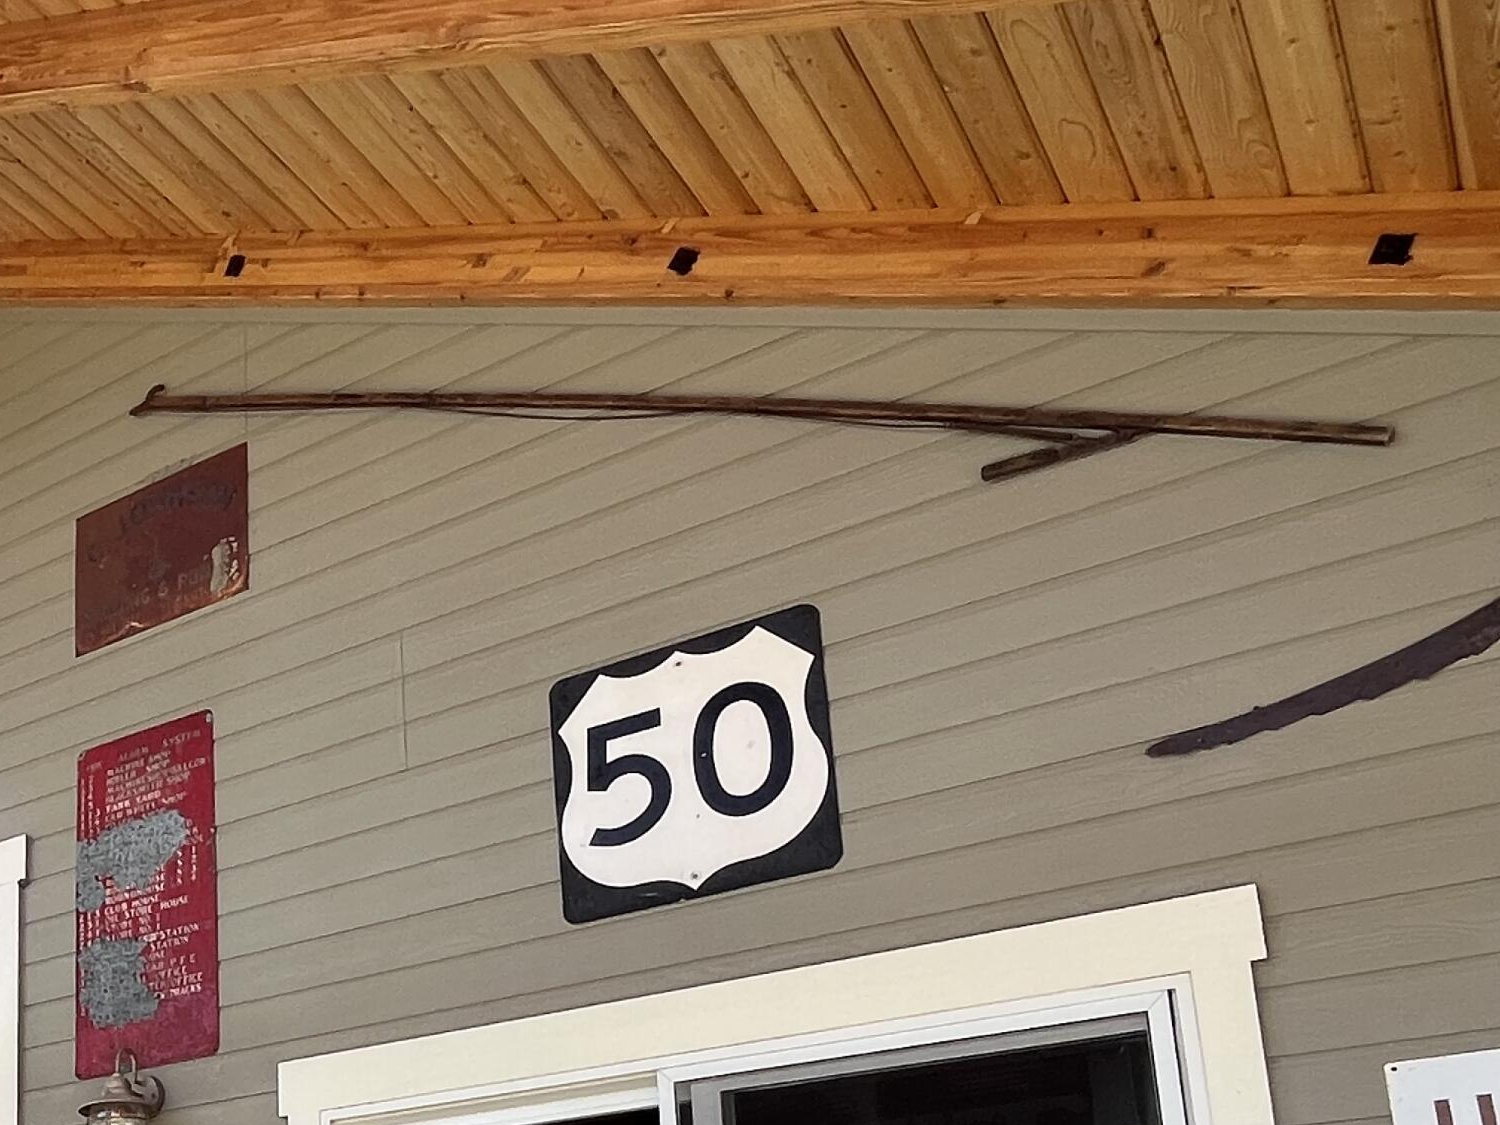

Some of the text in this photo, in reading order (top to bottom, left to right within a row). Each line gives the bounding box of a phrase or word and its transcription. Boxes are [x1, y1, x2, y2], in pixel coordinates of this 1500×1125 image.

[587, 682, 794, 847] 50
[104, 894, 161, 916] CLUB HOUSE
